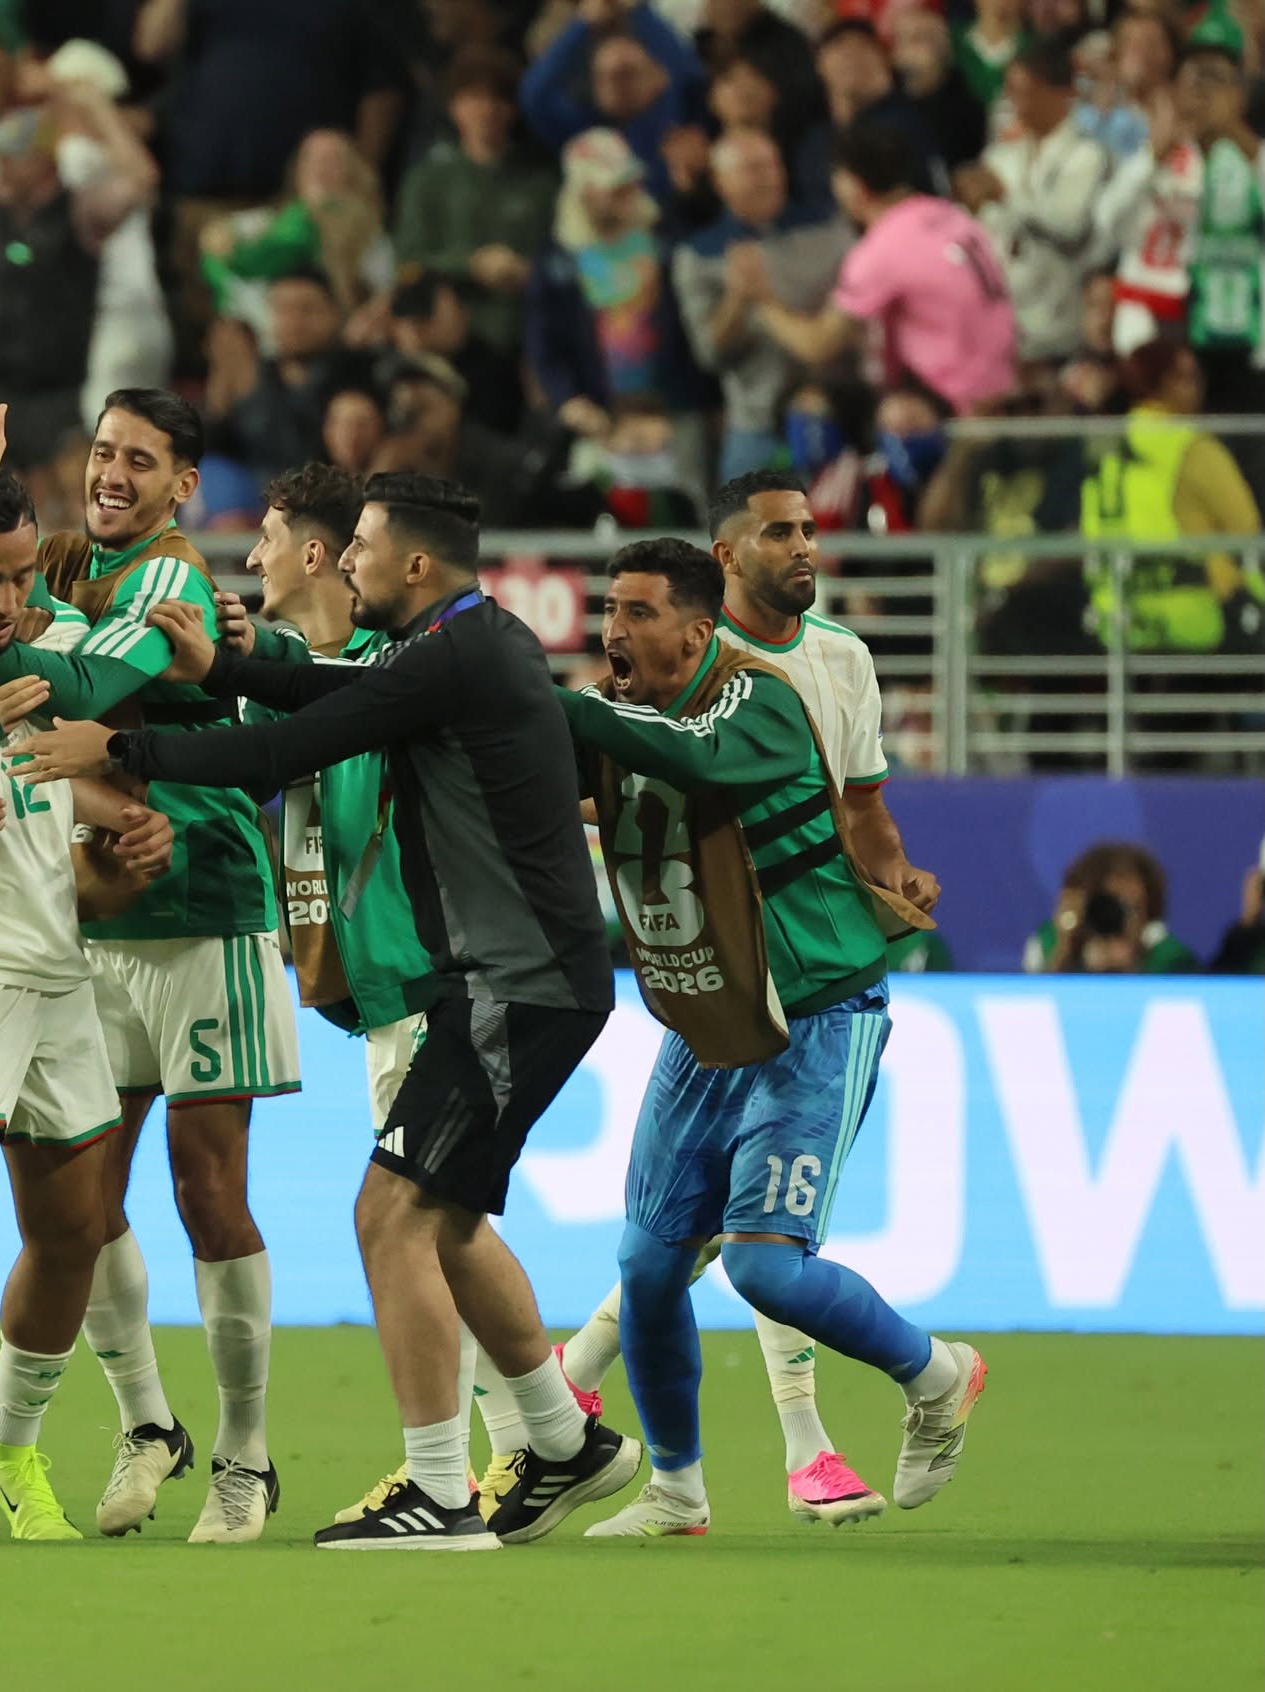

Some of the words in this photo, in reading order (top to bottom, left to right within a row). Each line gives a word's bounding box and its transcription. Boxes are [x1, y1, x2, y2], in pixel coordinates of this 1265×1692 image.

[288, 899, 330, 926] 20
[639, 912, 681, 931] FIFA
[636, 947, 680, 967] WORLD
[680, 946, 714, 968] CUP
[641, 965, 724, 995] 2026
[189, 1018, 221, 1082] 5
[763, 1154, 821, 1216] 16
